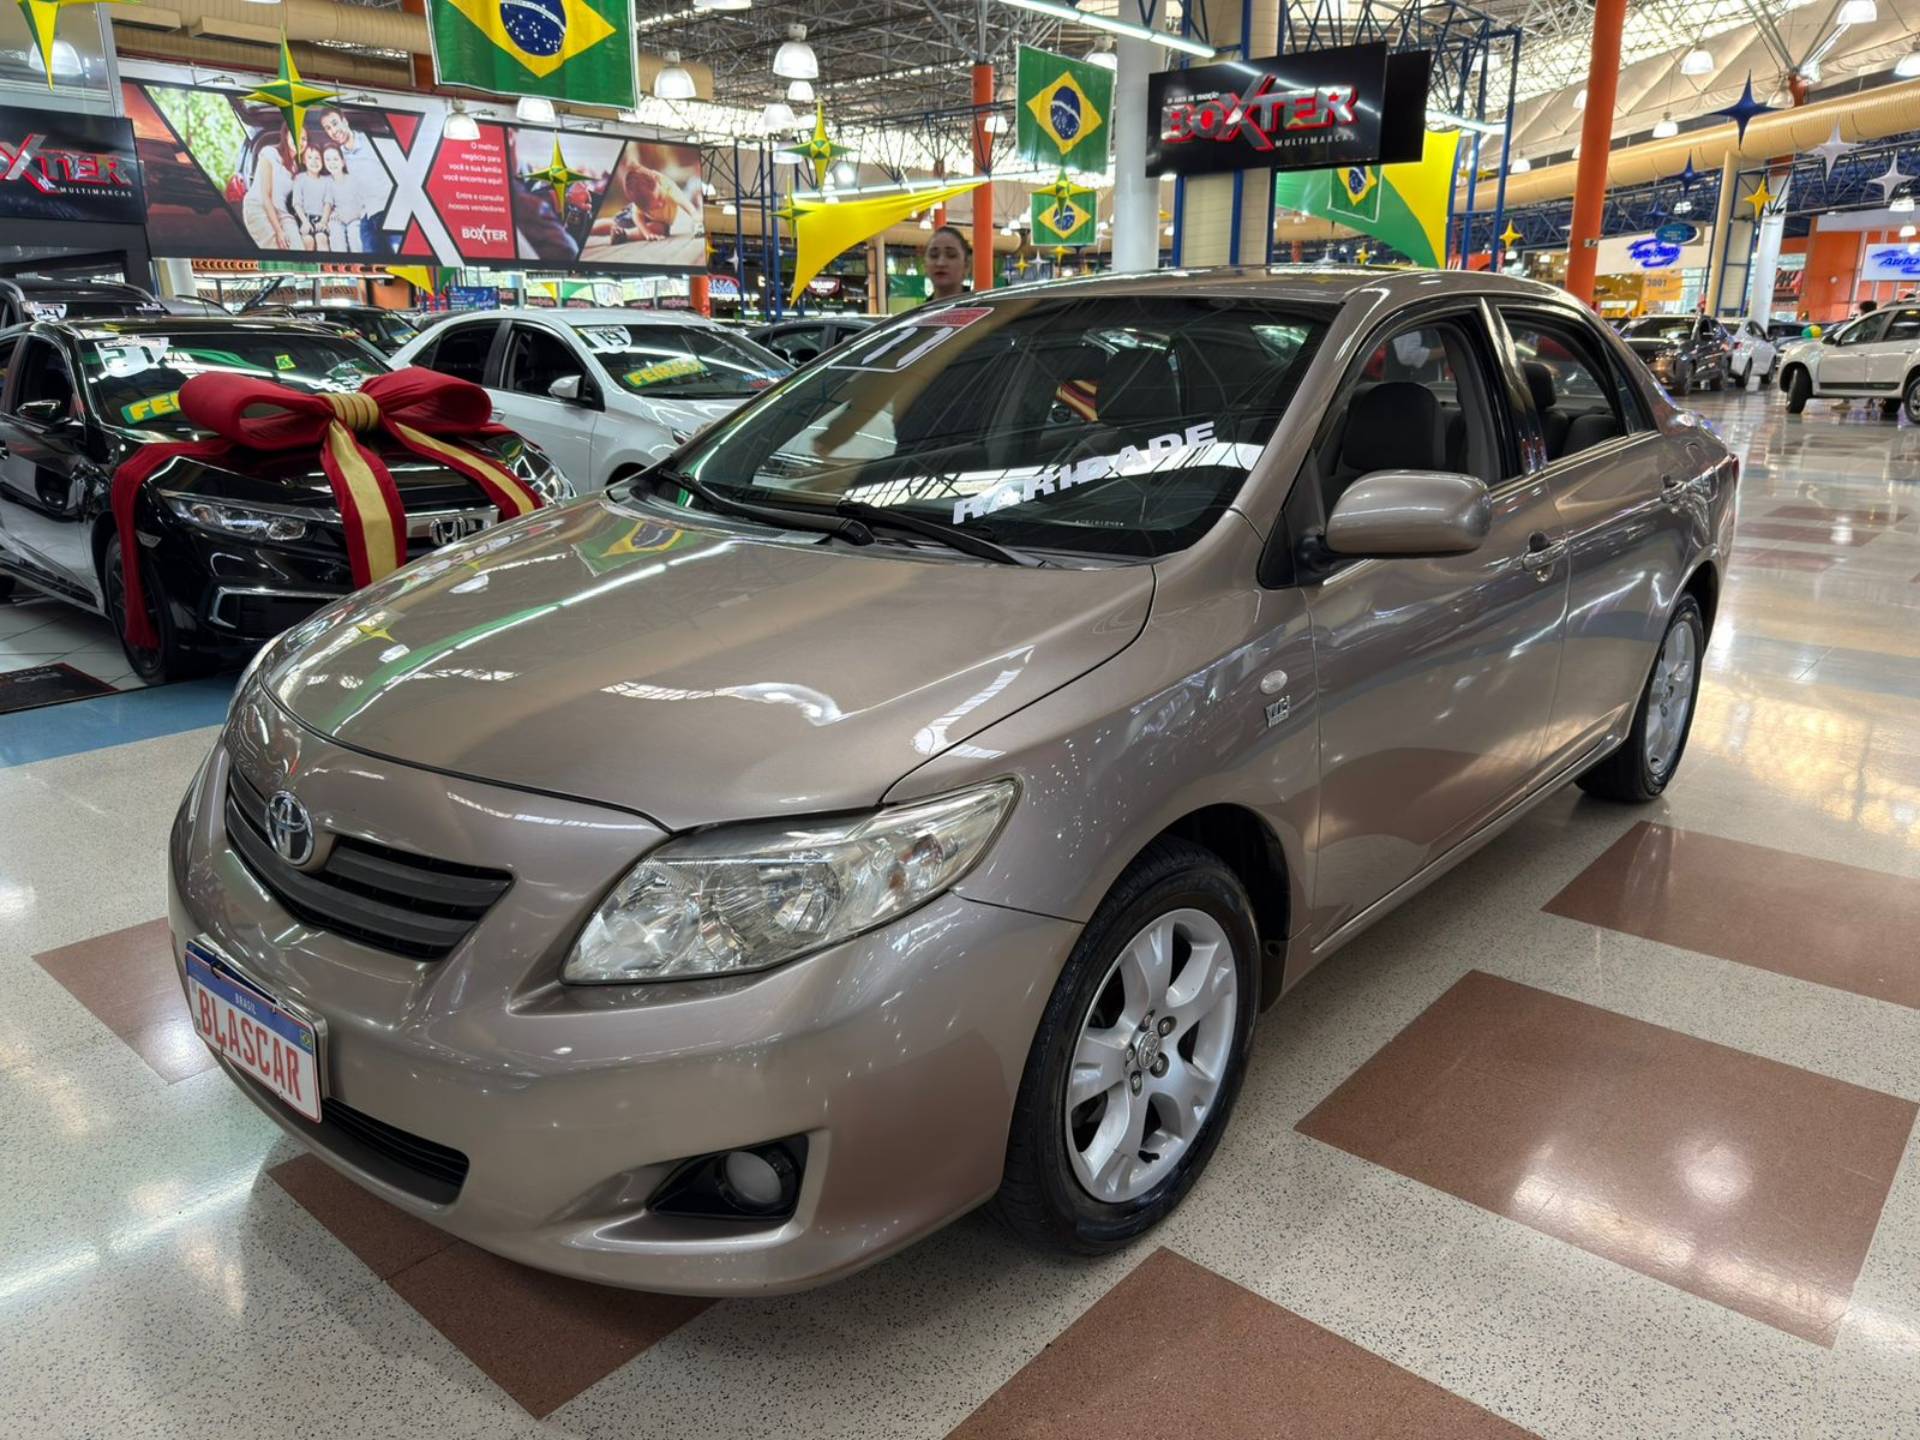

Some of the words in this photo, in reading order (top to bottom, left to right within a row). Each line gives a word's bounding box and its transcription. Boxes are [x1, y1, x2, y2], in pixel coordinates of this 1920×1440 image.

[1160, 73, 1358, 151] BOXTER
[1274, 133, 1356, 147] MULTIMARCAS
[0, 134, 132, 194] XTER
[59, 187, 132, 198] MULTIMARCAS
[462, 224, 508, 245] BOXTER
[235, 992, 257, 1016] BRASIL
[198, 987, 302, 1102] BLASCAR
